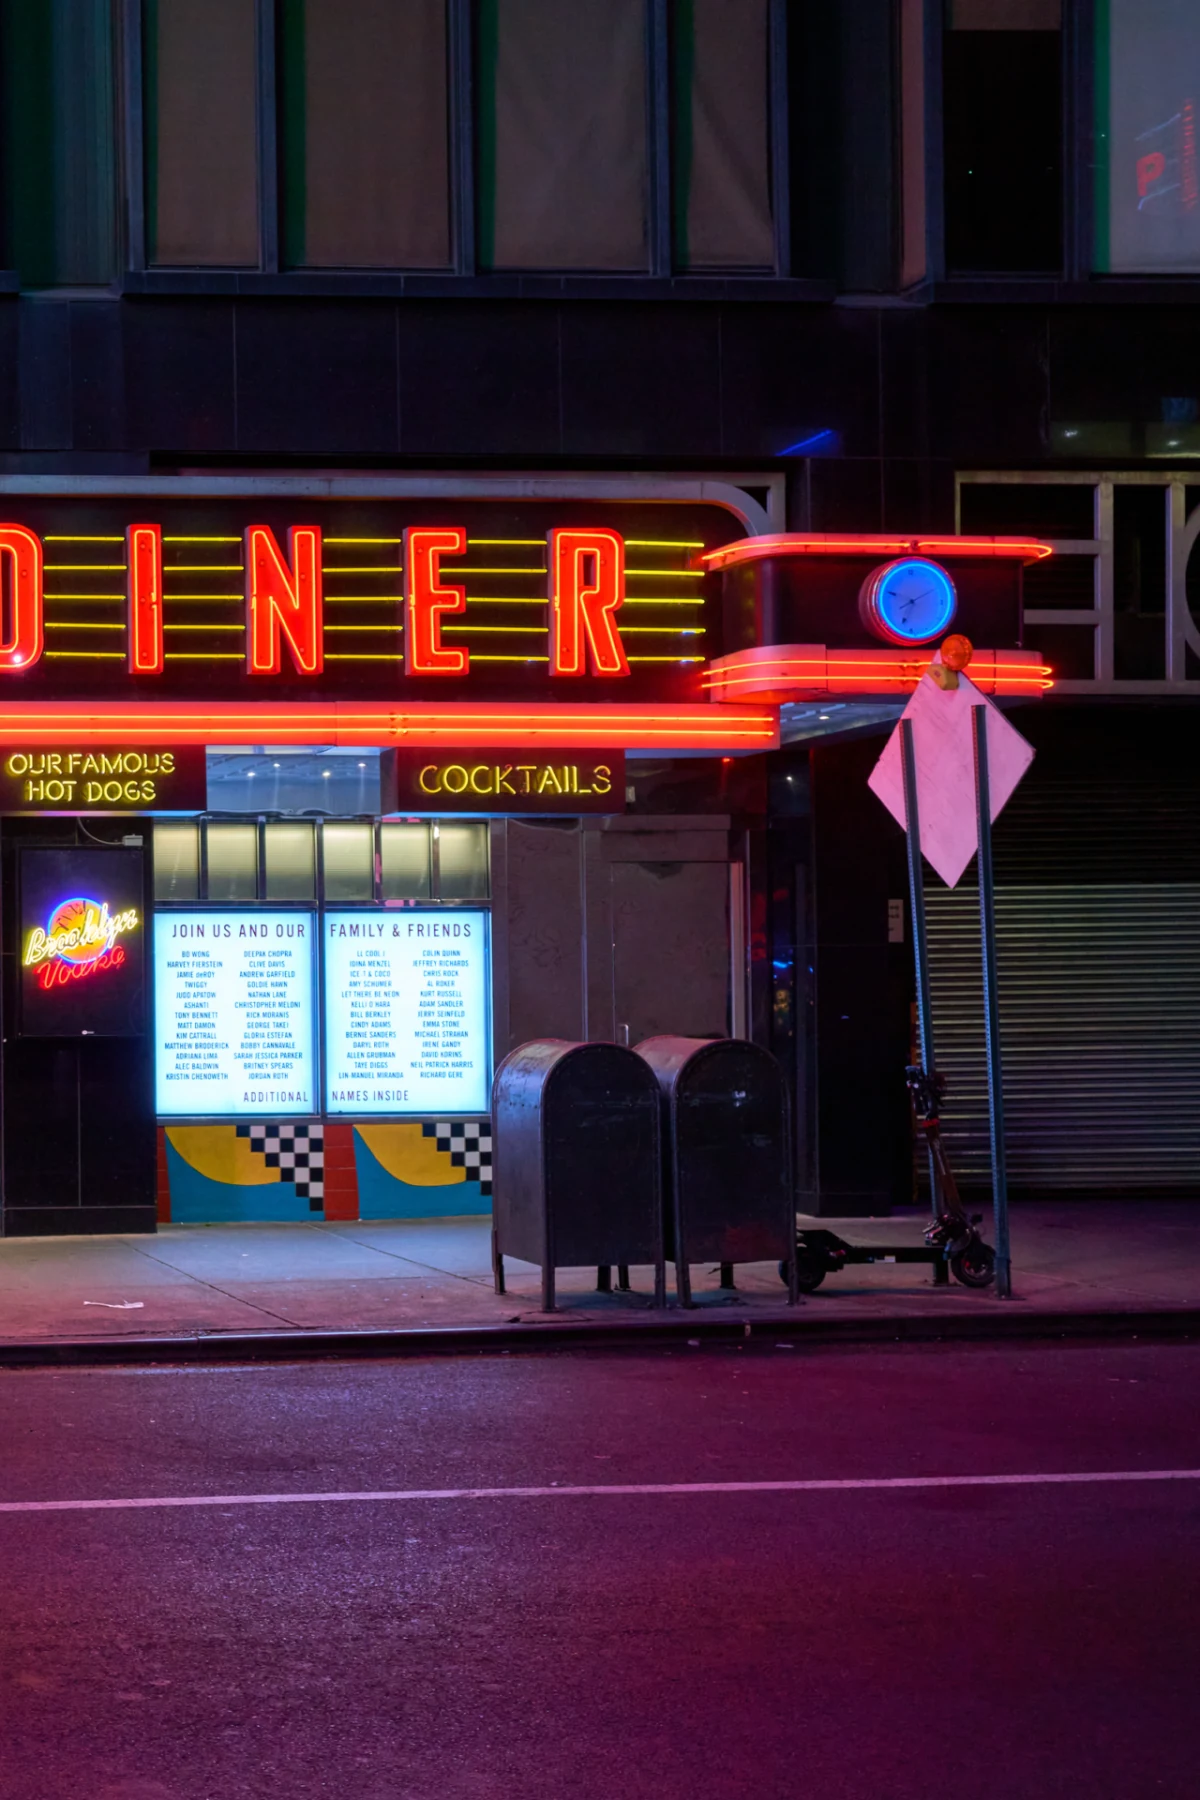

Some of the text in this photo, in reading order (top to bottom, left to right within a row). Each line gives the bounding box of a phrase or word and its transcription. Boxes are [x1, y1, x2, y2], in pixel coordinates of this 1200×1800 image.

[8, 752, 176, 775] OUR FAMOUS
[419, 764, 612, 795] COCKTAILS
[28, 780, 156, 802] HOT DOGS
[25, 902, 139, 965] Brooklyn
[172, 924, 305, 938] JOIN US AND OUR
[330, 923, 471, 937] FAMILY & FRIENDS
[37, 945, 126, 989] Vodka
[249, 960, 285, 968] CLIVE DAVIS
[239, 970, 265, 978] ANDREW
[246, 1021, 289, 1029] GEORGE TAKEI
[243, 1031, 292, 1039] GLORIA ESTEFAN
[164, 1042, 193, 1050] MATTHEW
[346, 1051, 365, 1059] ALLEN
[354, 1061, 368, 1069] TAYE
[243, 1091, 308, 1103] ADDITIONAL
[332, 1090, 409, 1102] NAMES INSIDE
